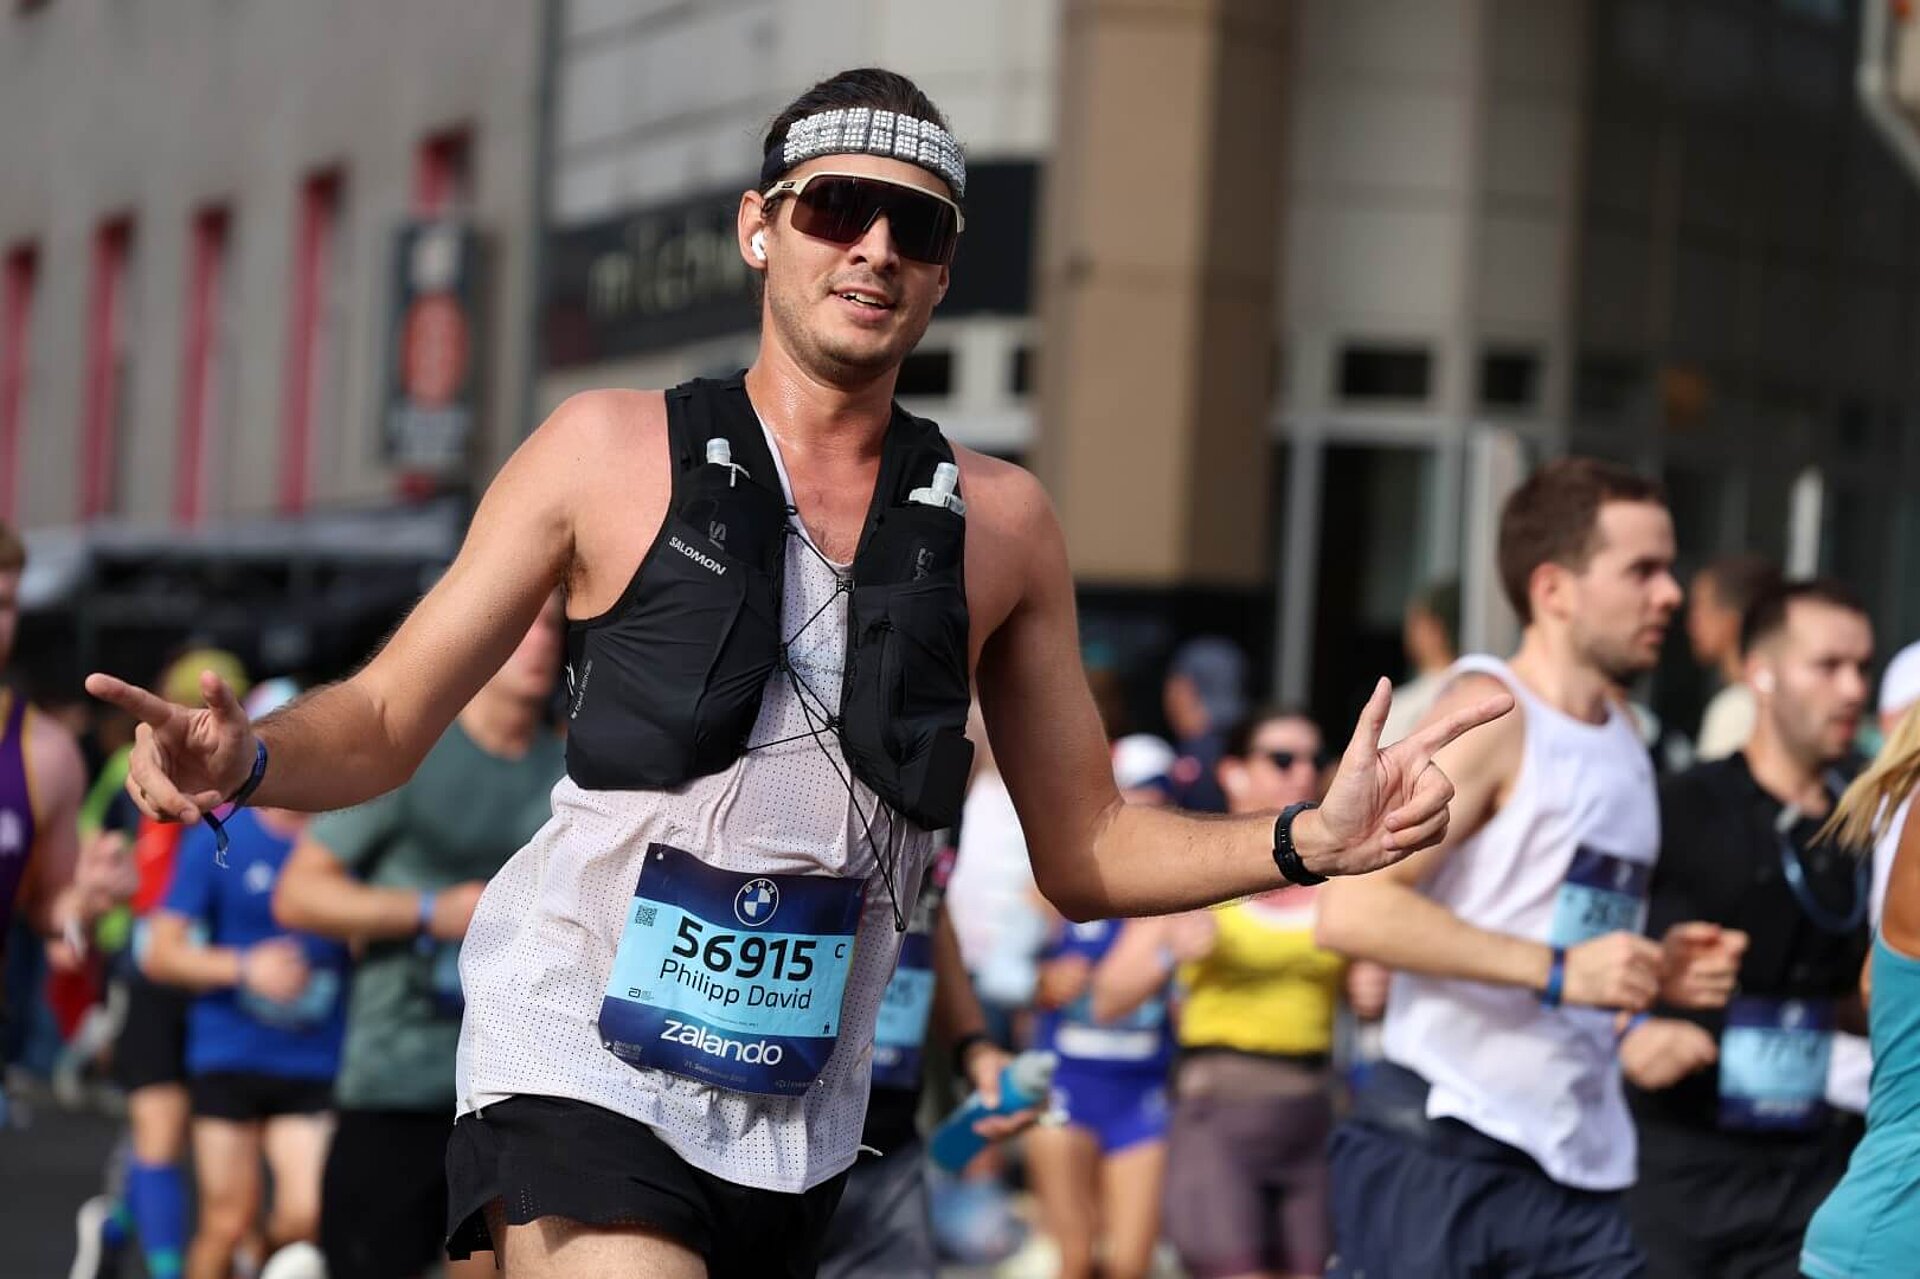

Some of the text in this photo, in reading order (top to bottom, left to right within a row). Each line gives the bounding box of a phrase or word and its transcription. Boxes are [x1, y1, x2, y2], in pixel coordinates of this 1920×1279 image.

[669, 536, 727, 575] SALOMON
[671, 915, 817, 982] 56915
[834, 943, 846, 959] C
[659, 958, 813, 1010] Philipp David
[660, 1018, 783, 1067] zalando
